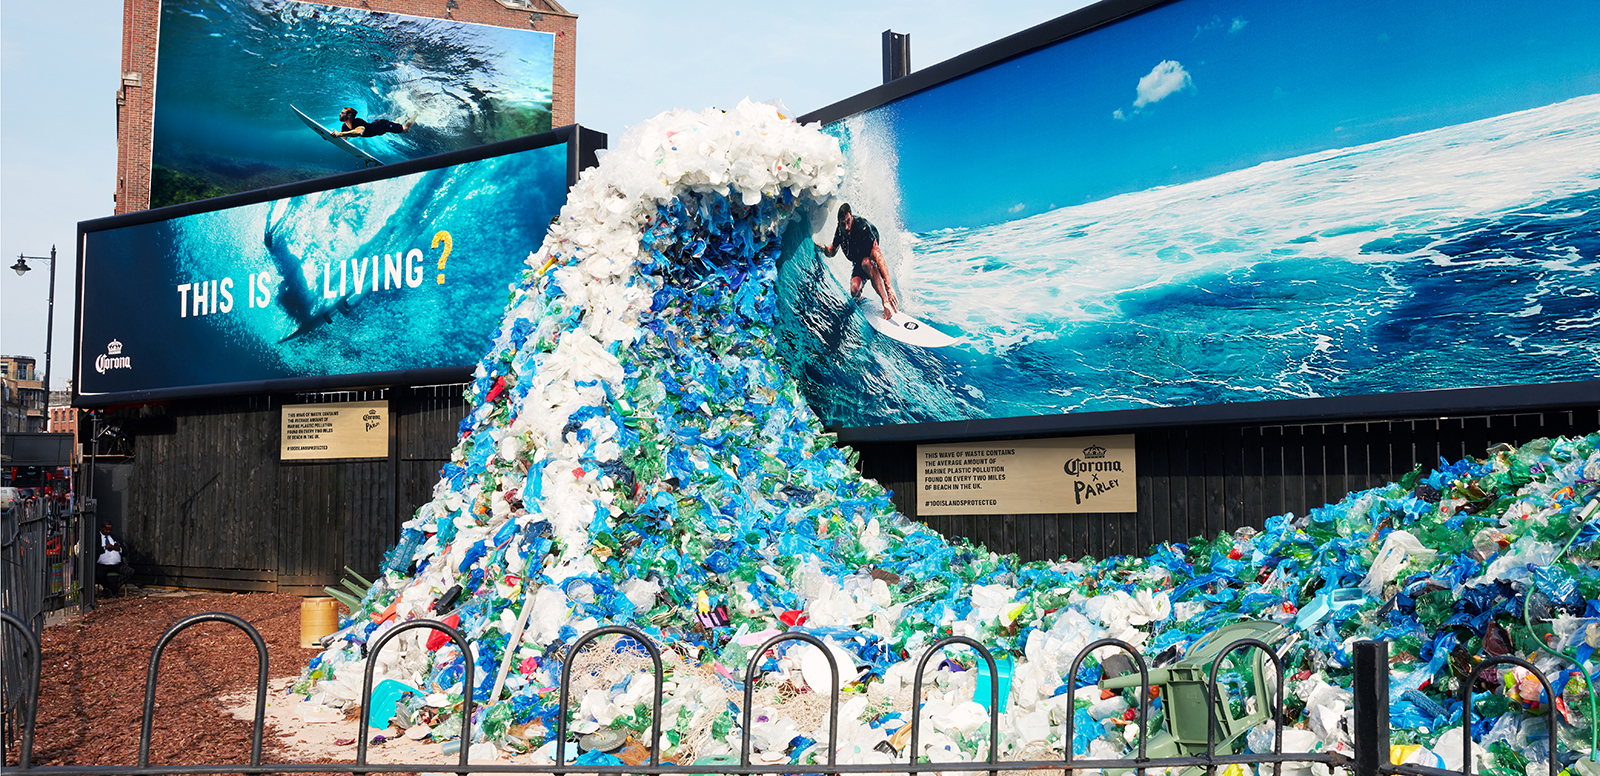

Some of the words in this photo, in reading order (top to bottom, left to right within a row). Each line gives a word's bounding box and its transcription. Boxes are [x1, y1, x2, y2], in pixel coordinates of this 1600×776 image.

[177, 277, 233, 318] THIS
[249, 271, 271, 308] IS
[323, 230, 453, 299] LIVING?
[95, 354, 132, 375] Corona
[1064, 458, 1123, 477] Corona
[1074, 479, 1119, 505] PARLEY
